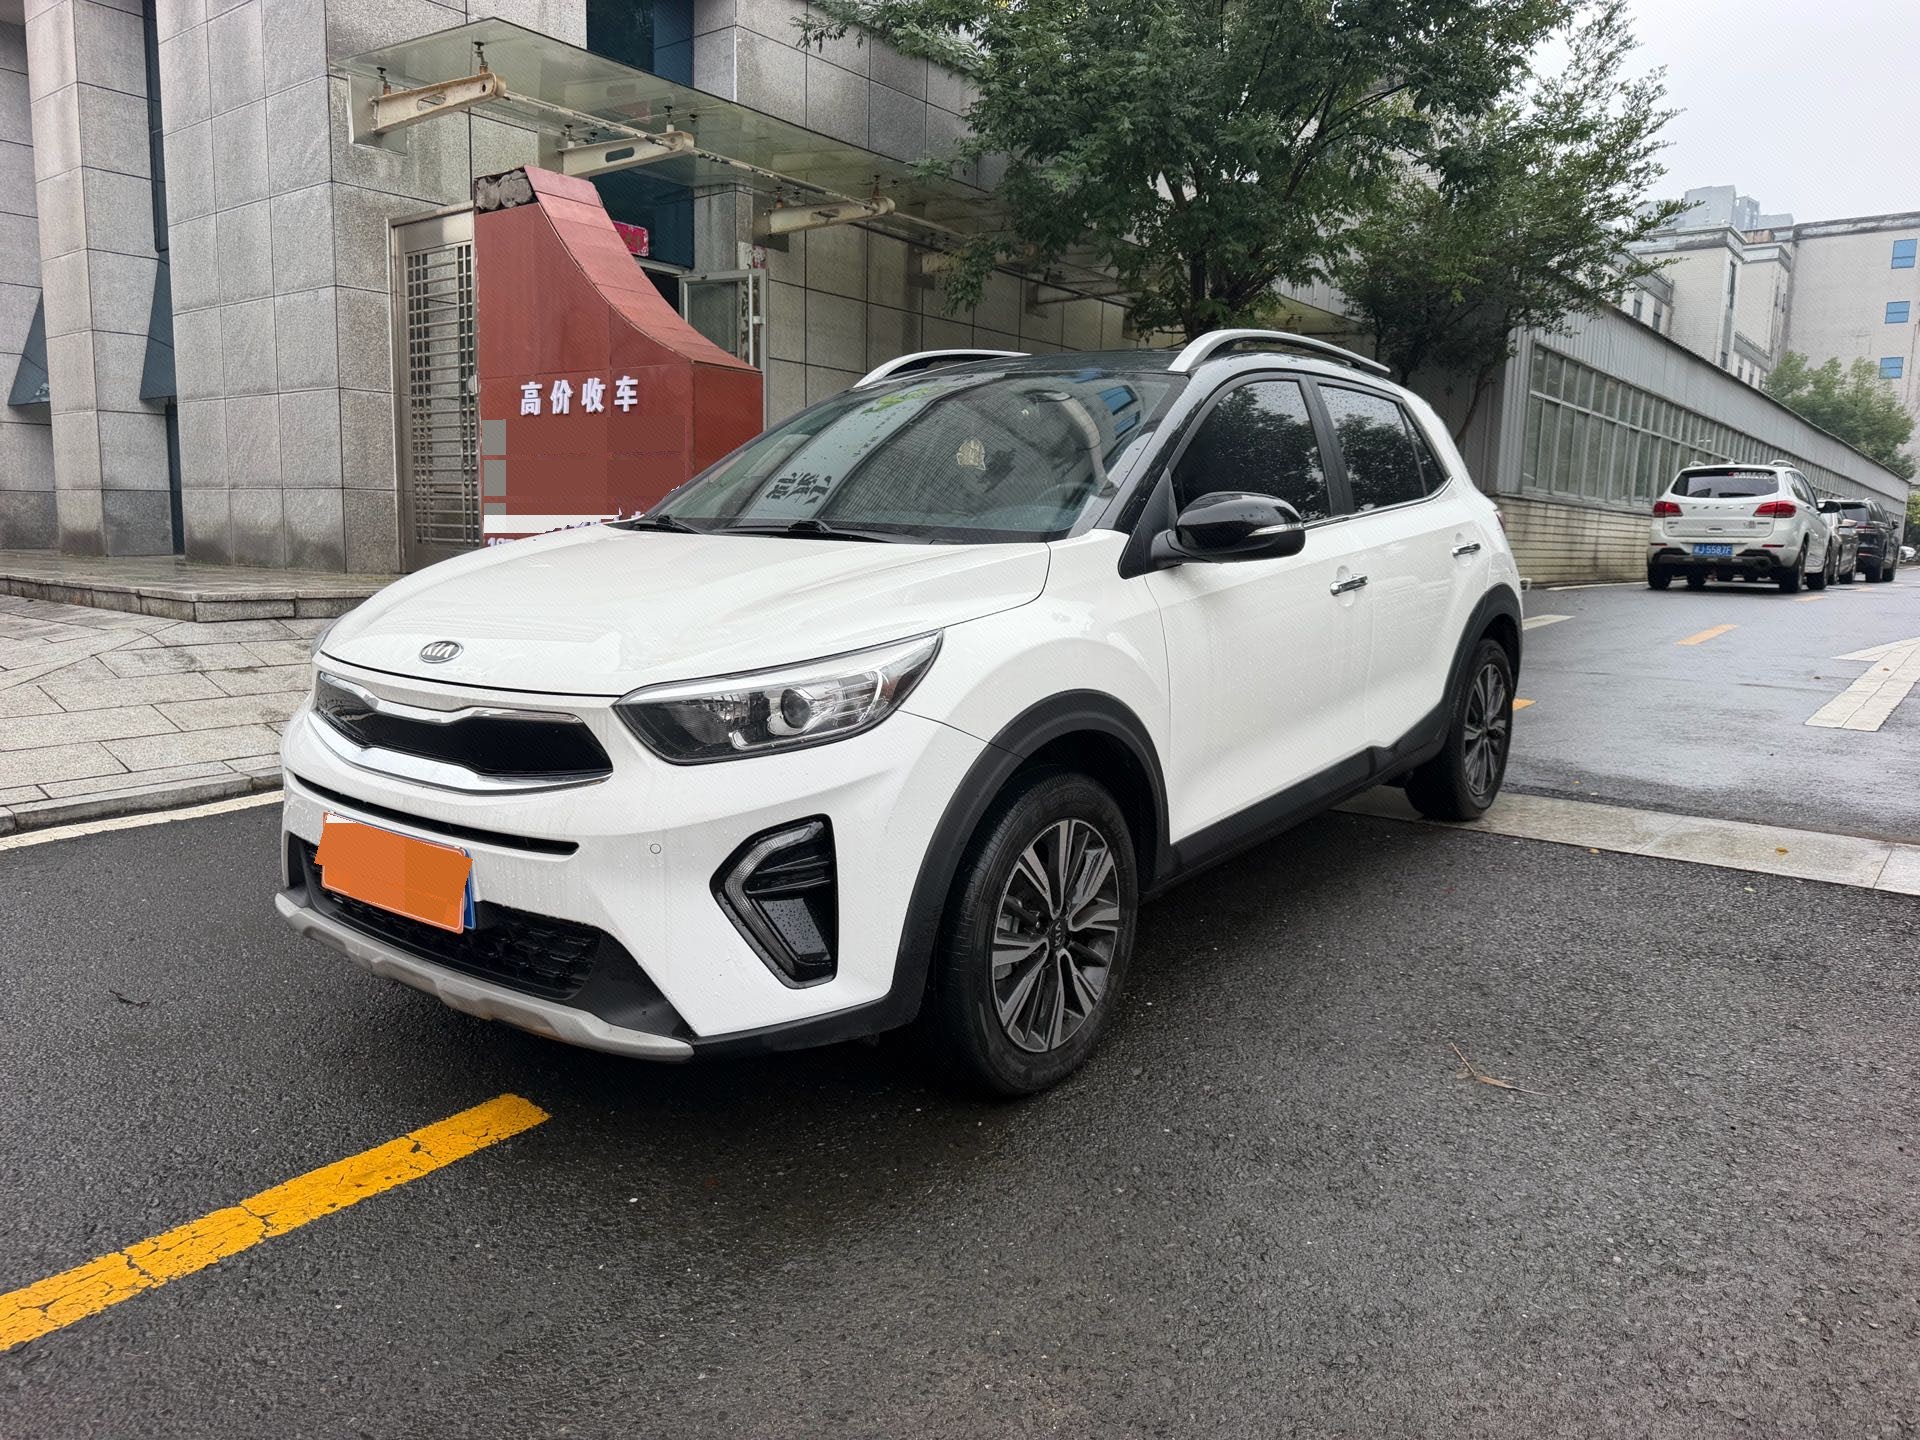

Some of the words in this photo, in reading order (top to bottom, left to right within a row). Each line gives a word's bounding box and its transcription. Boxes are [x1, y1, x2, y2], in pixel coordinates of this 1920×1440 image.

[520, 375, 639, 416] 高价收车
[422, 642, 456, 658] KIA
